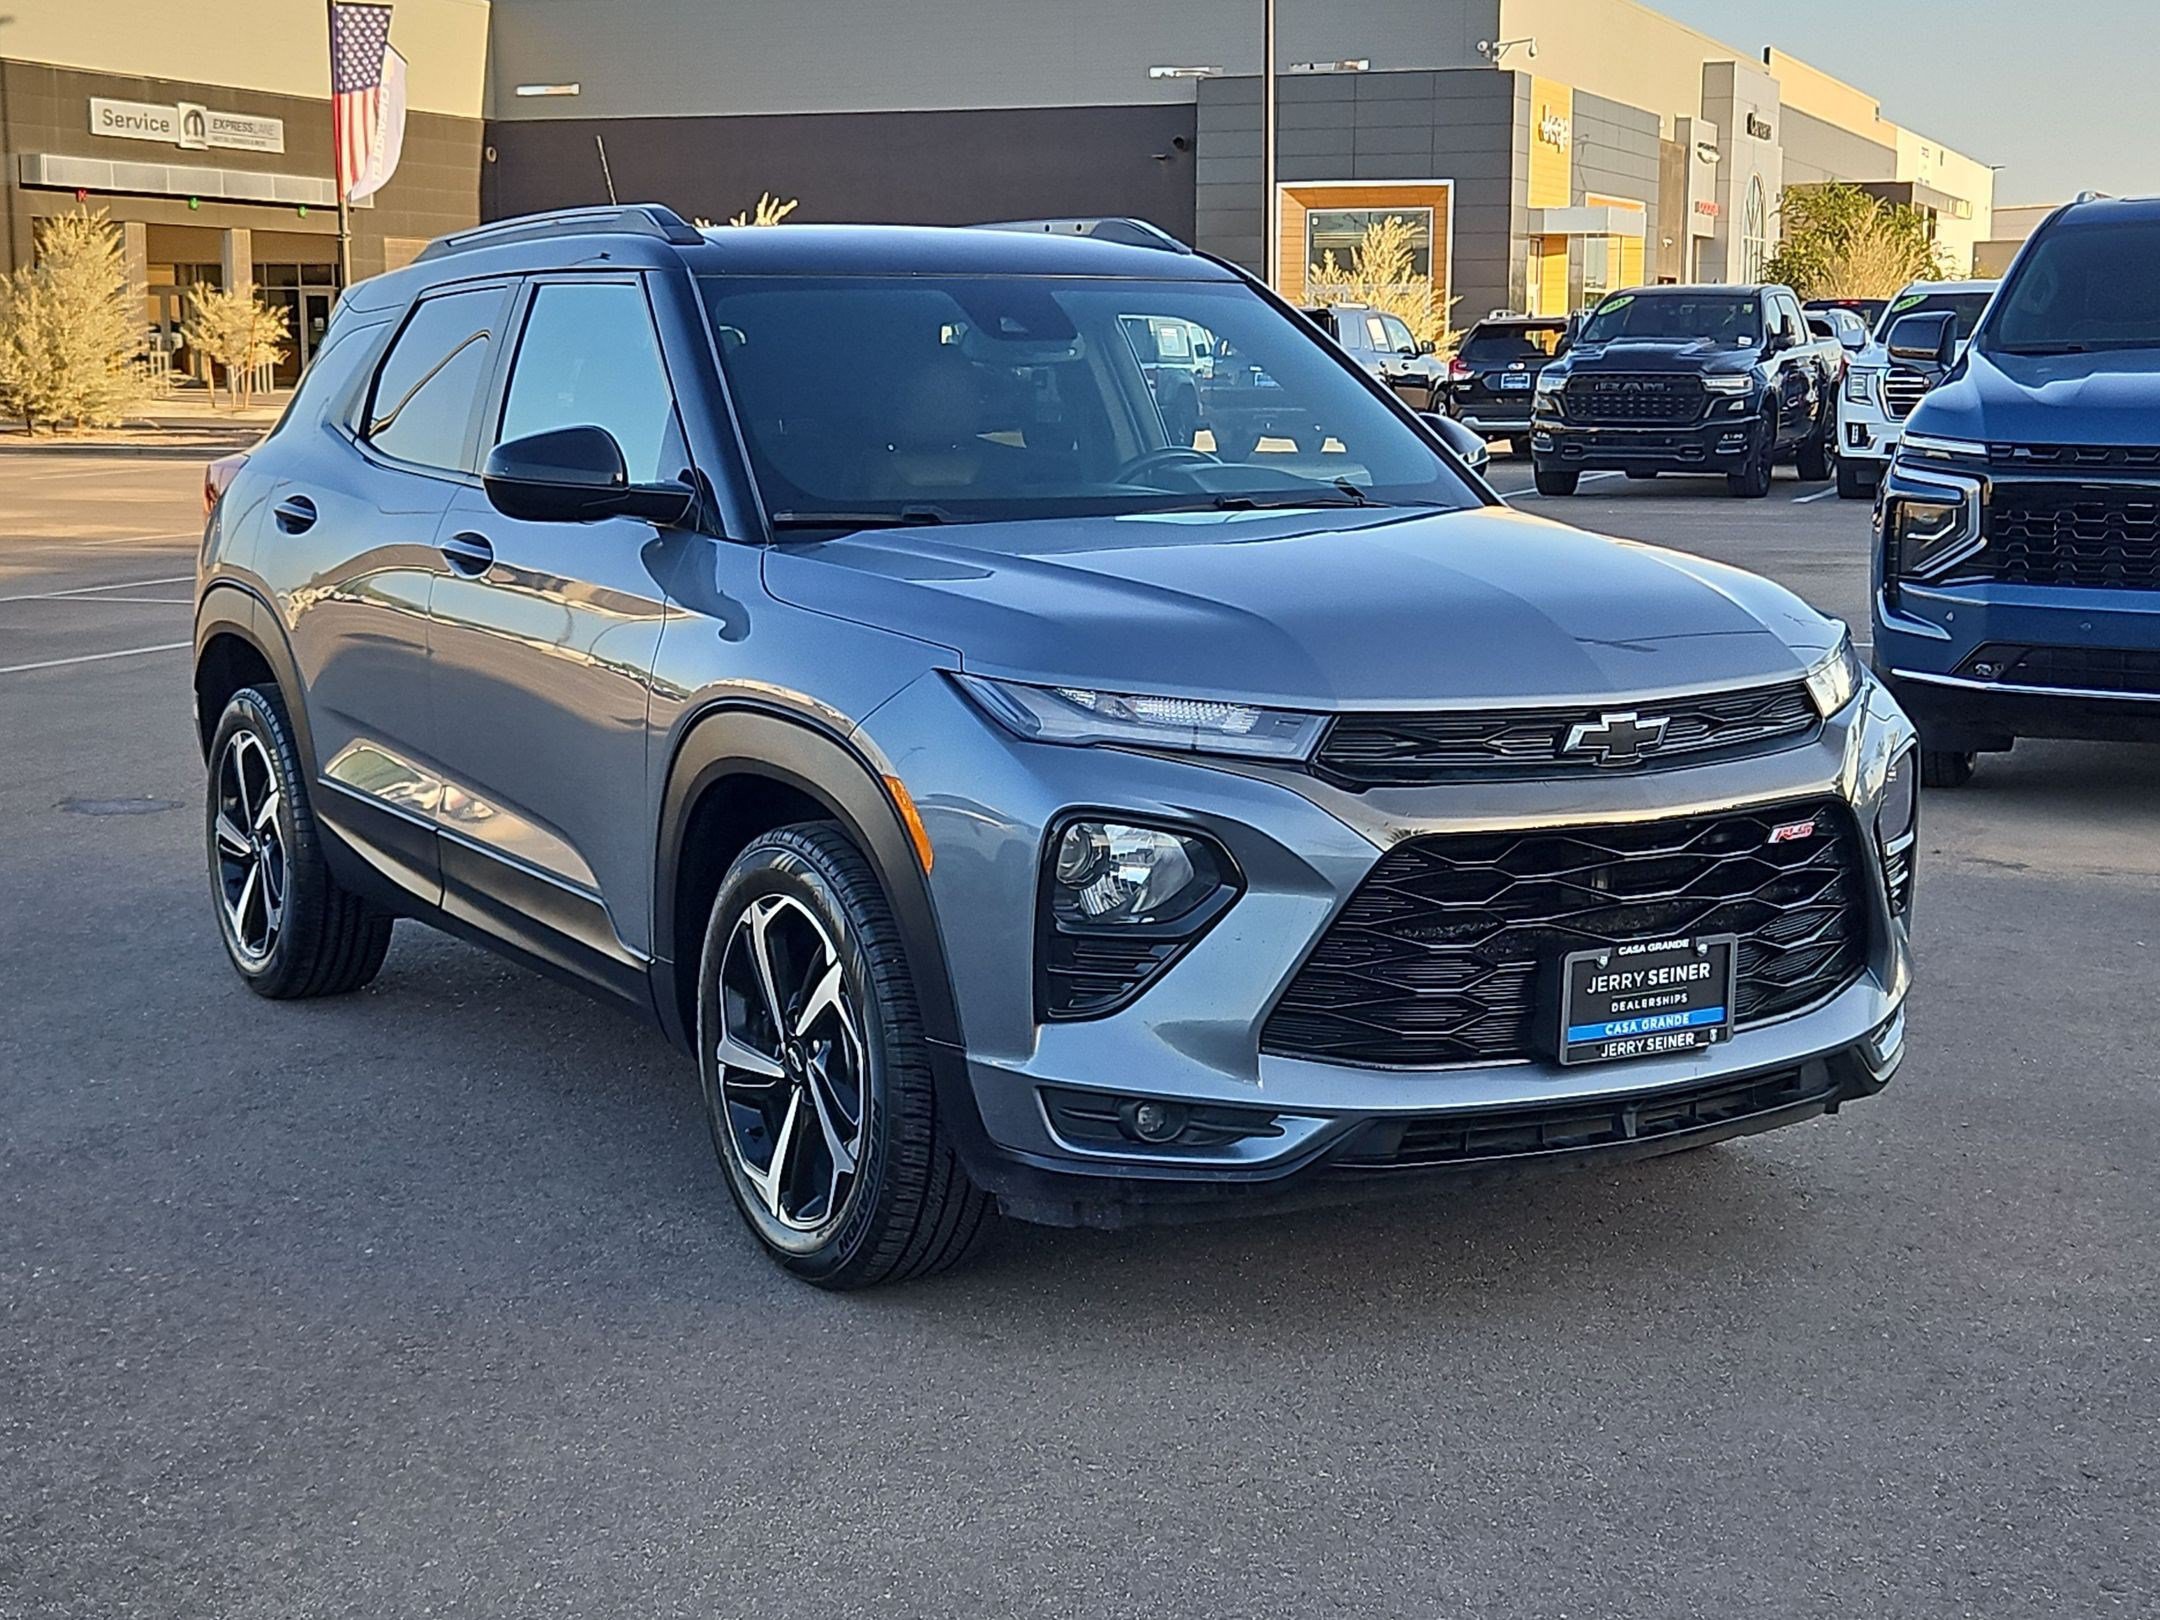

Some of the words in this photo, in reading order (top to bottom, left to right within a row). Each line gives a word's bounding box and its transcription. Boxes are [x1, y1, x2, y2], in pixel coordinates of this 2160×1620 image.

[102, 108, 171, 132] Service
[1539, 103, 1569, 153] Jeep
[1600, 382, 1665, 392] RAM
[1770, 821, 1815, 843] RS
[1618, 944, 1646, 956] CASA
[1647, 939, 1690, 952] GRANDE
[1586, 970, 1645, 994] JERRY
[1647, 962, 1711, 986] SEINER
[1611, 993, 1688, 1013] DEALERSHIPS
[1605, 1020, 1637, 1036] CASA
[1641, 1014, 1690, 1031] GRANDE
[1601, 1038, 1645, 1058] JERRY
[1646, 1032, 1695, 1051] SEINER
